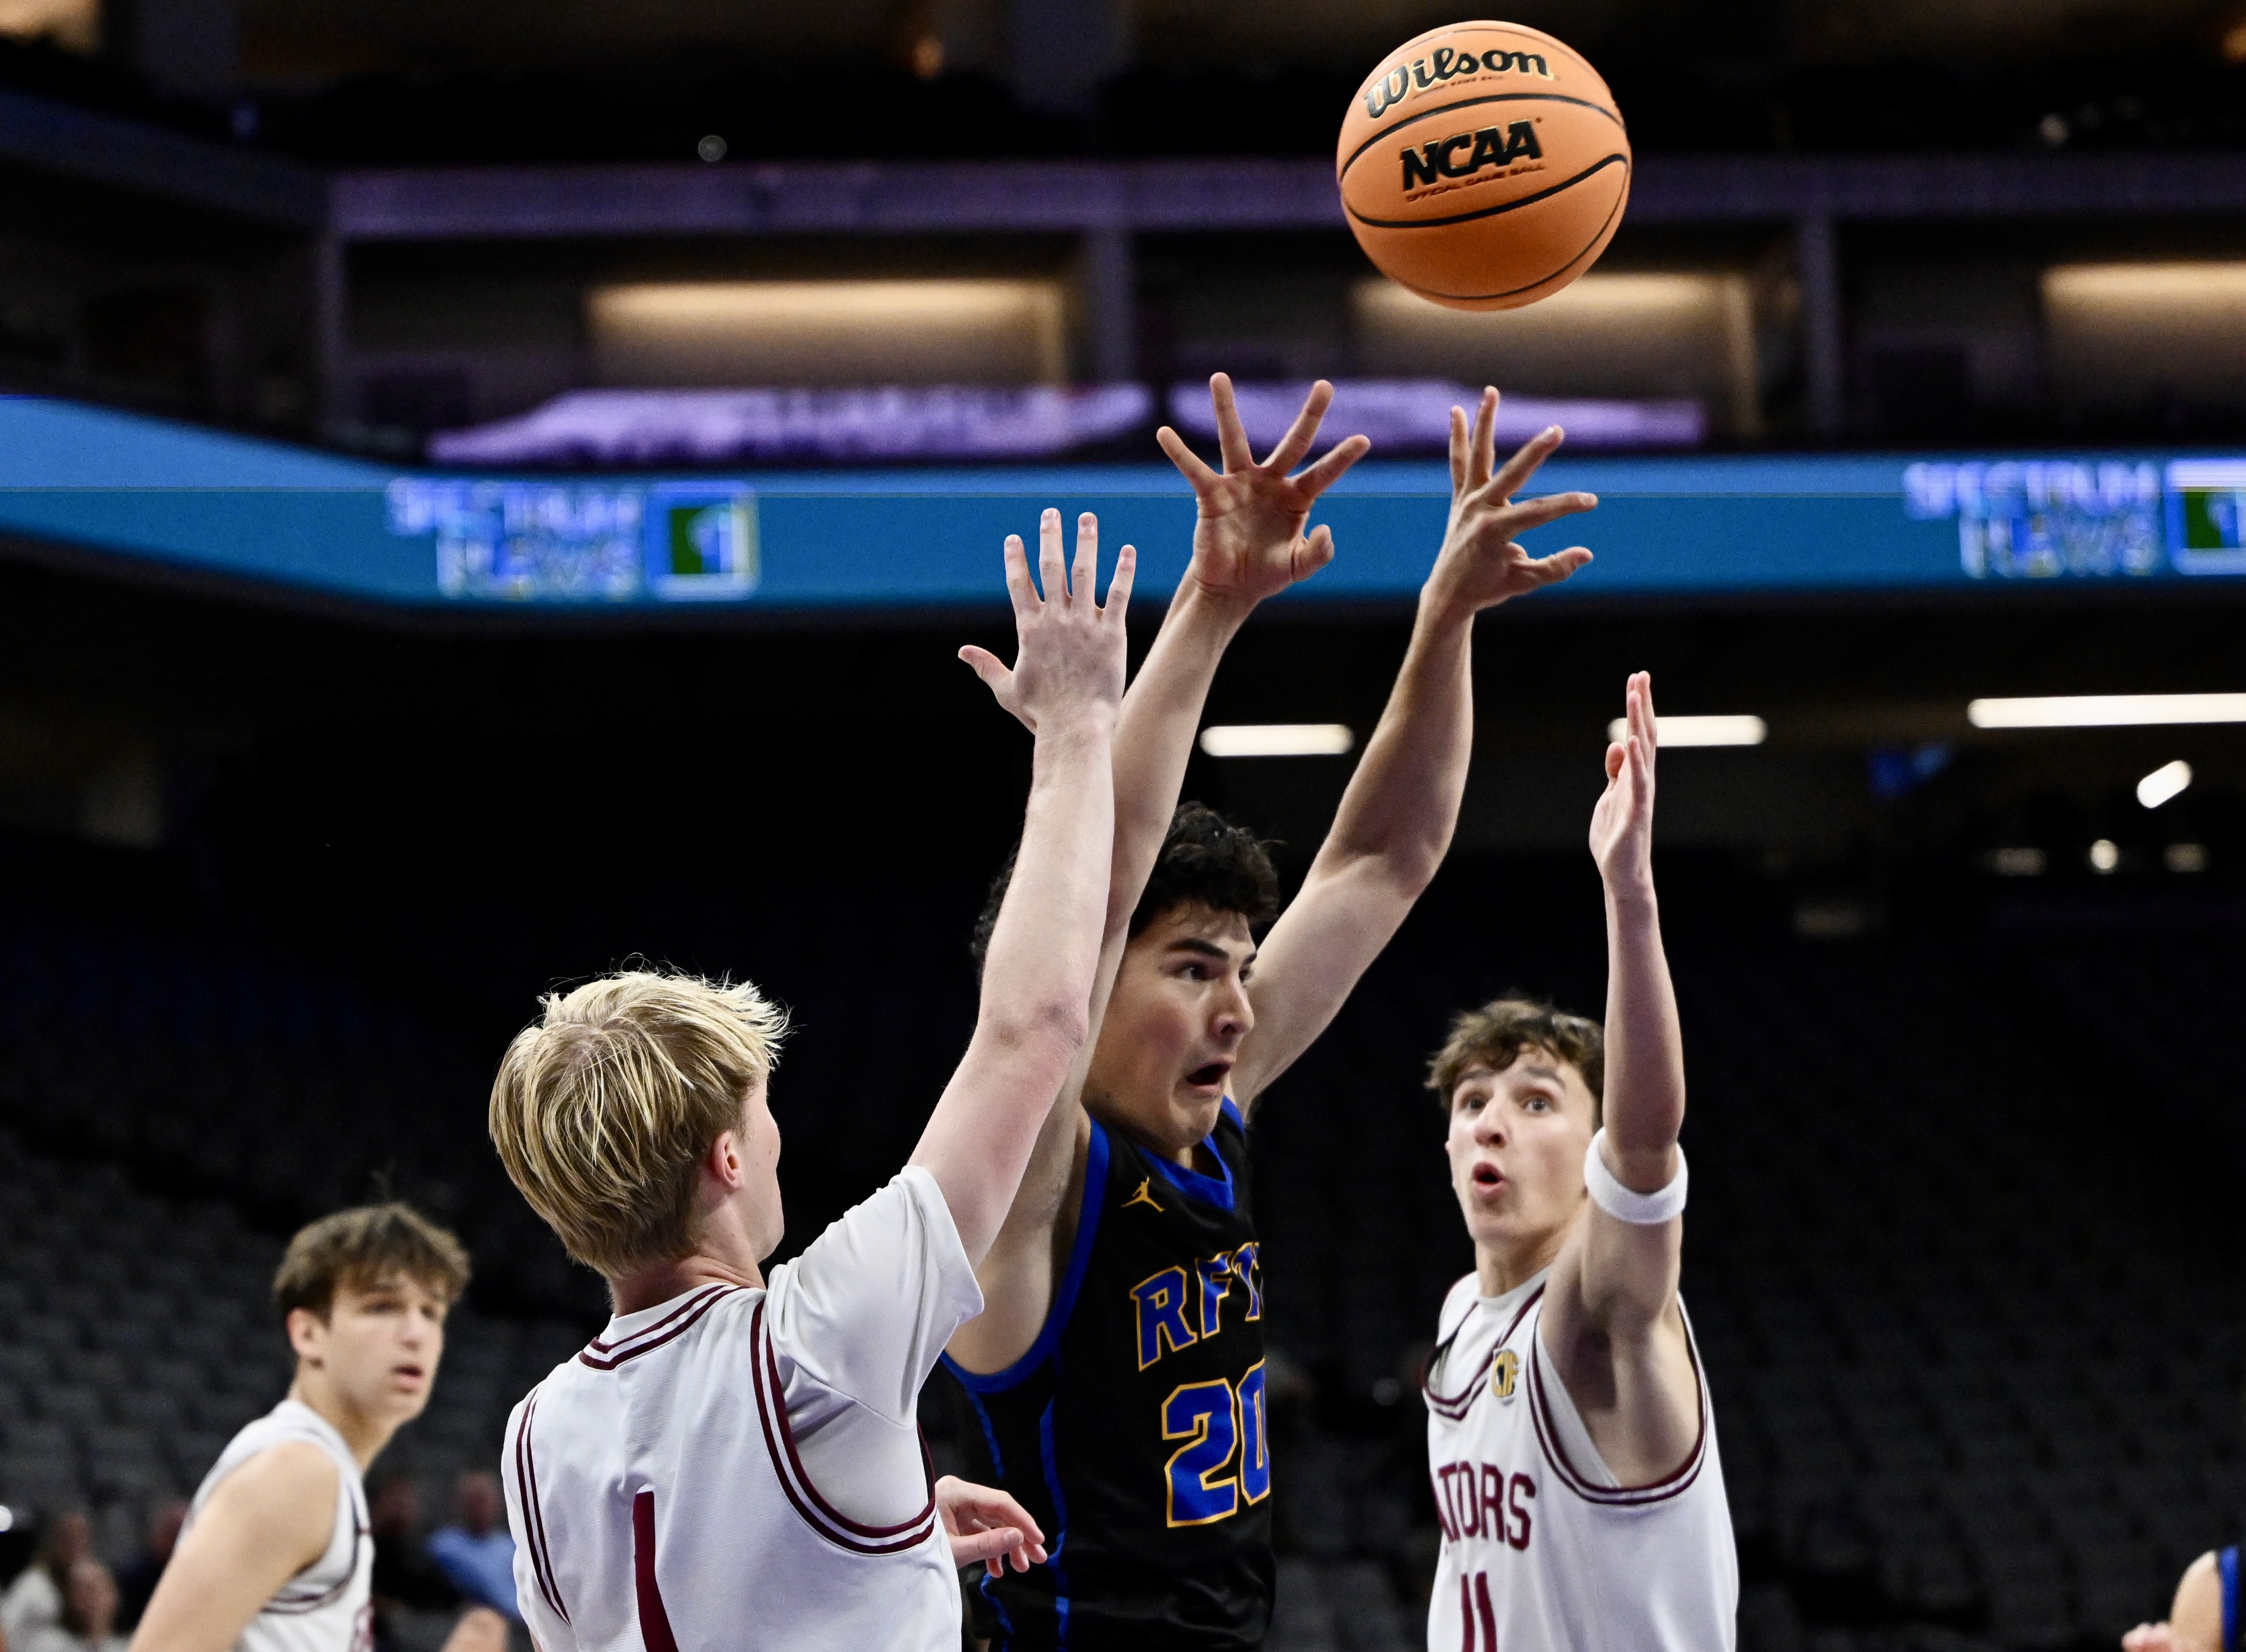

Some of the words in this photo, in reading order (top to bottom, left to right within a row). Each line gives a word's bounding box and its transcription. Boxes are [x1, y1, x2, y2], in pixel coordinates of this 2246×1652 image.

[1363, 47, 1555, 120] Wilson
[1399, 118, 1543, 191] NCAA
[1161, 1357, 1270, 1529] 20
